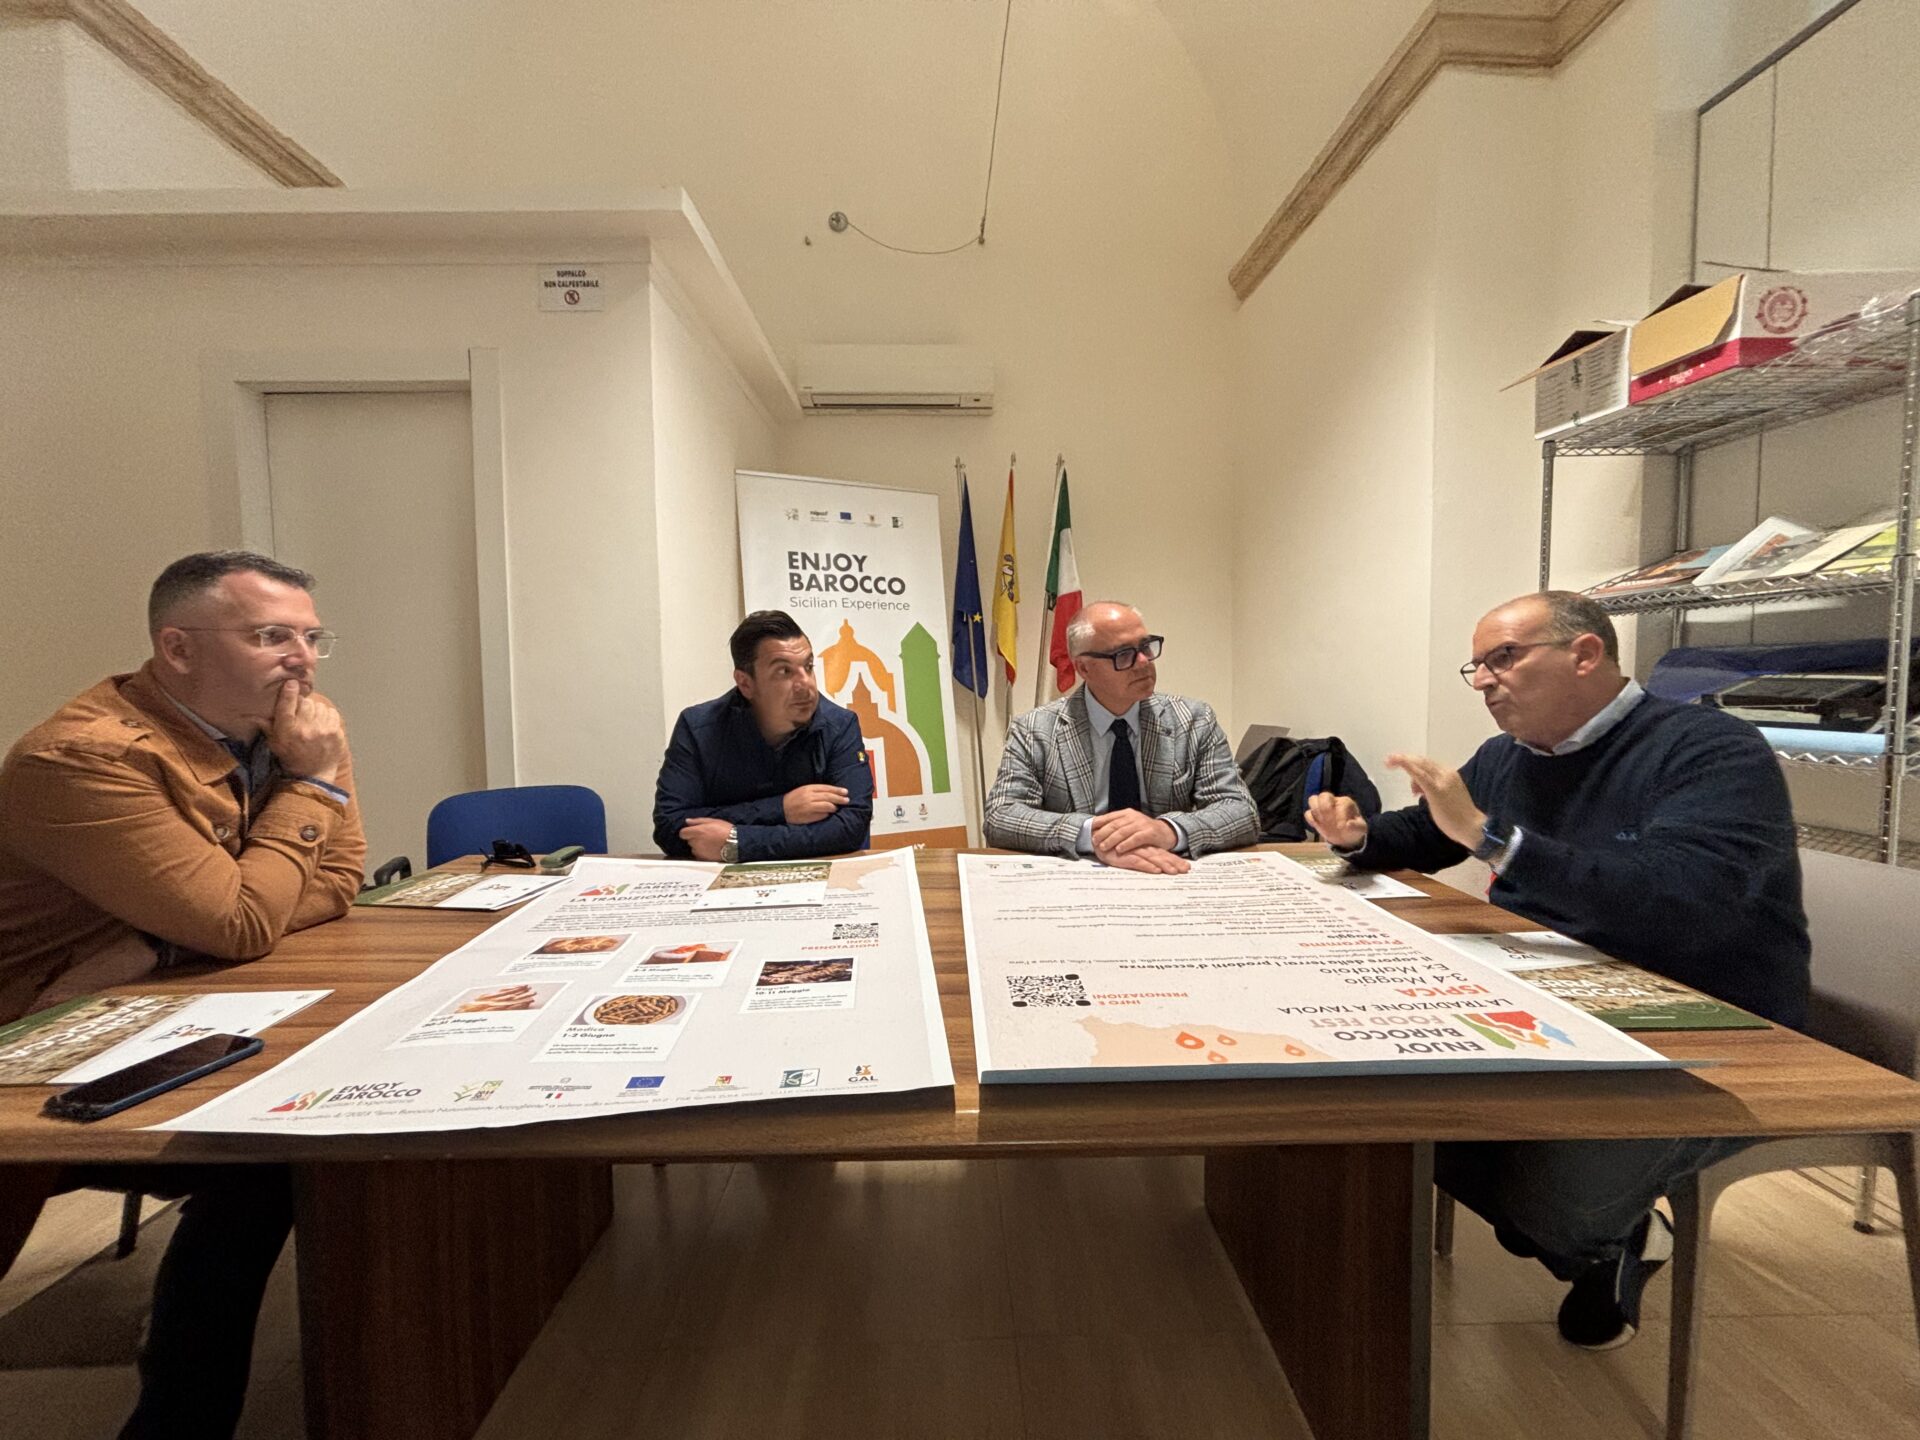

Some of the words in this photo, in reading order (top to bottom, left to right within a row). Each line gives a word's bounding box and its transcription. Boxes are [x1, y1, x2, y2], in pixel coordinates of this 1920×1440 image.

[544, 280, 556, 288] NON
[558, 280, 599, 288] CALPESTABILE
[787, 551, 868, 572] ENJOY
[789, 572, 906, 596] BAROCCO
[789, 596, 837, 609] Sicilian
[842, 597, 911, 611] Experience
[591, 893, 677, 902] TRADIZIONE
[1298, 939, 1404, 948] Programma
[1211, 960, 1272, 969] prodotti
[1319, 965, 1419, 975] Mattatoio
[1423, 963, 1450, 971] Ex
[1344, 976, 1427, 987] Maggio
[1433, 972, 1468, 983] 3-4
[1092, 991, 1189, 1000] PRENOTAZIONI
[1395, 984, 1491, 998] ISPICA
[1553, 988, 1654, 997] ROCCA
[1354, 1003, 1367, 1012] A
[1372, 999, 1488, 1011] TRADIZIONE
[1490, 998, 1514, 1006] LA
[1277, 1004, 1353, 1015] TAVOLA
[1311, 1017, 1365, 1028] FEST
[1369, 1014, 1445, 1026] FOOD
[1333, 1027, 1465, 1041] BAROCCO
[1395, 1041, 1486, 1054] ENJOY
[848, 1075, 879, 1083] GAL
[338, 1081, 405, 1094] ENJOY
[327, 1088, 422, 1102] BAROCCO
